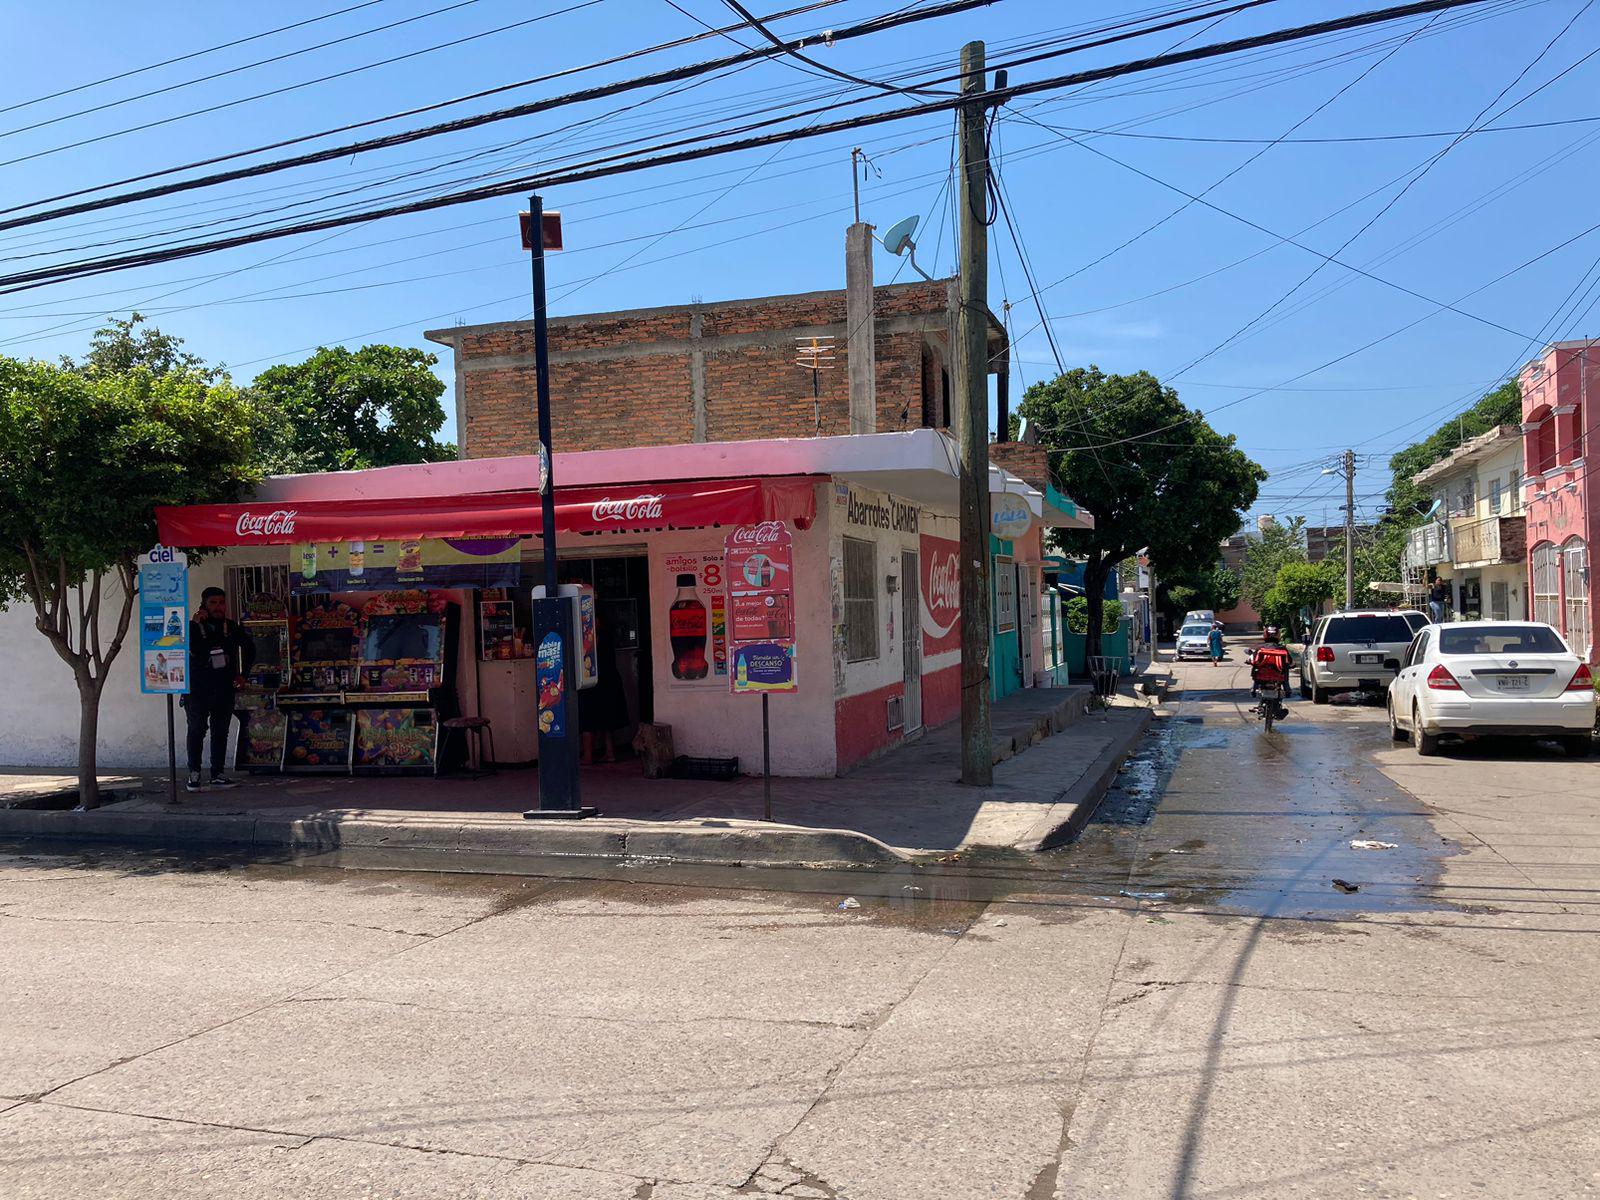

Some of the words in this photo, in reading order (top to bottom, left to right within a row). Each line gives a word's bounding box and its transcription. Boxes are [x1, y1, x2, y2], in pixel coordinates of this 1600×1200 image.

[592, 494, 666, 521] Coca-Cola
[847, 490, 890, 529] Abarrotes
[236, 510, 297, 536] Coca-Cola
[734, 525, 781, 543] Coca-Cola
[150, 546, 173, 562] ciel
[665, 555, 697, 565] amigos
